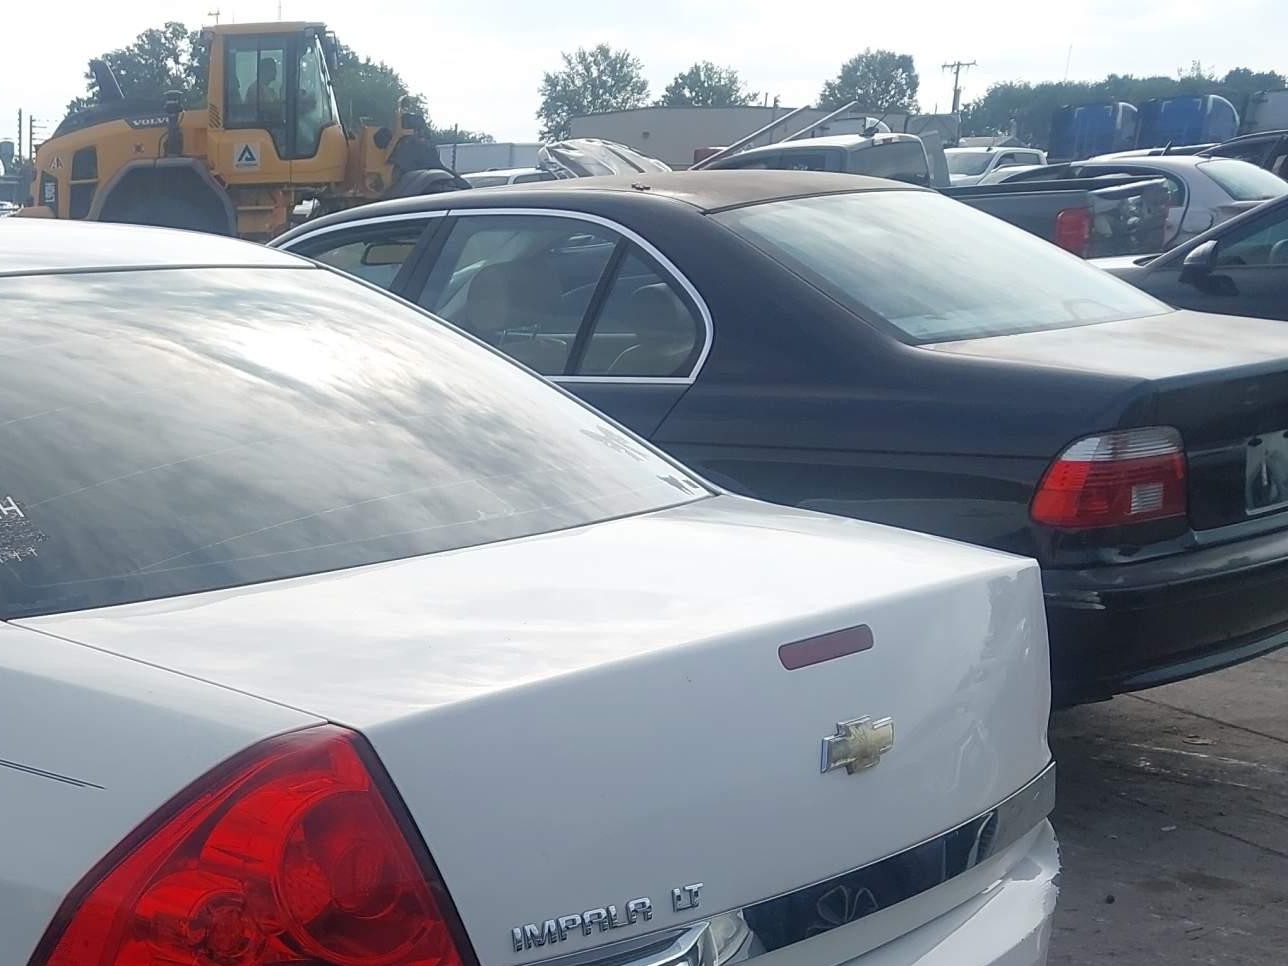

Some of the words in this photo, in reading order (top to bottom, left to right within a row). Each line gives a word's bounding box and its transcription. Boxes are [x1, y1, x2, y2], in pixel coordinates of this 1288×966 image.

[132, 117, 169, 126] VOLV
[512, 897, 652, 952] IMPALA
[672, 882, 704, 913] LT
